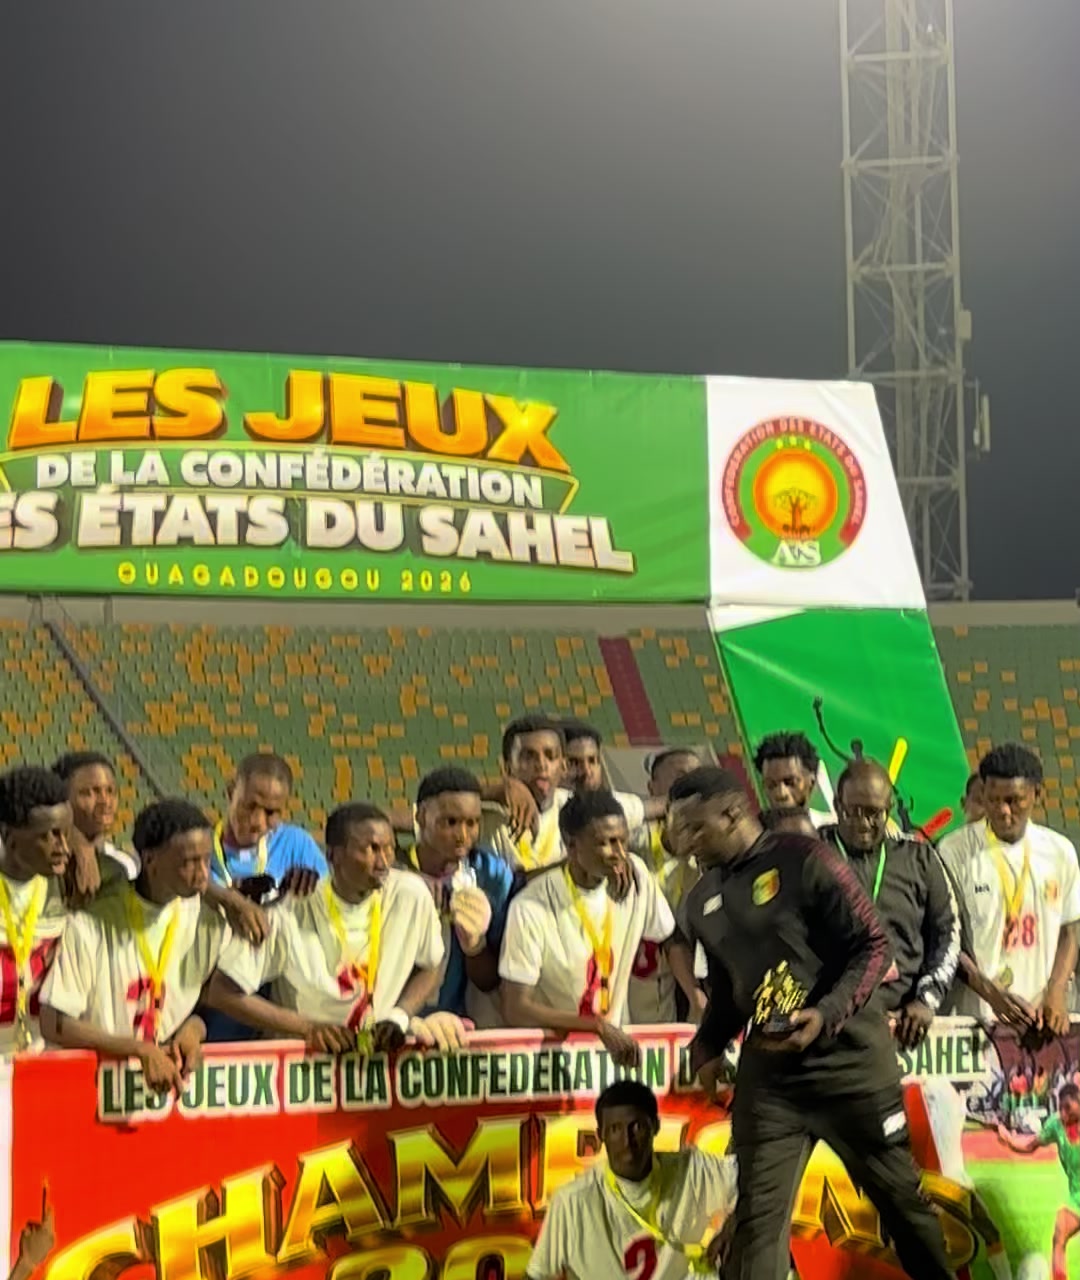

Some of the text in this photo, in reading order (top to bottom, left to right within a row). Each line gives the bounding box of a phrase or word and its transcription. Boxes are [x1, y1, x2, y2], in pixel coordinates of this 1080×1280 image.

[8, 367, 572, 474] LES JEUX
[37, 446, 543, 508] DE LA CONFÉDÉRATION
[77, 483, 290, 547] ÉTATS
[306, 496, 405, 551] DU
[419, 504, 635, 573] SAHEL
[117, 561, 472, 593] OUAGADOUGOU 2026
[182, 1064, 274, 1108] JEUX
[289, 1061, 334, 1104] DE
[346, 1058, 386, 1101] LA
